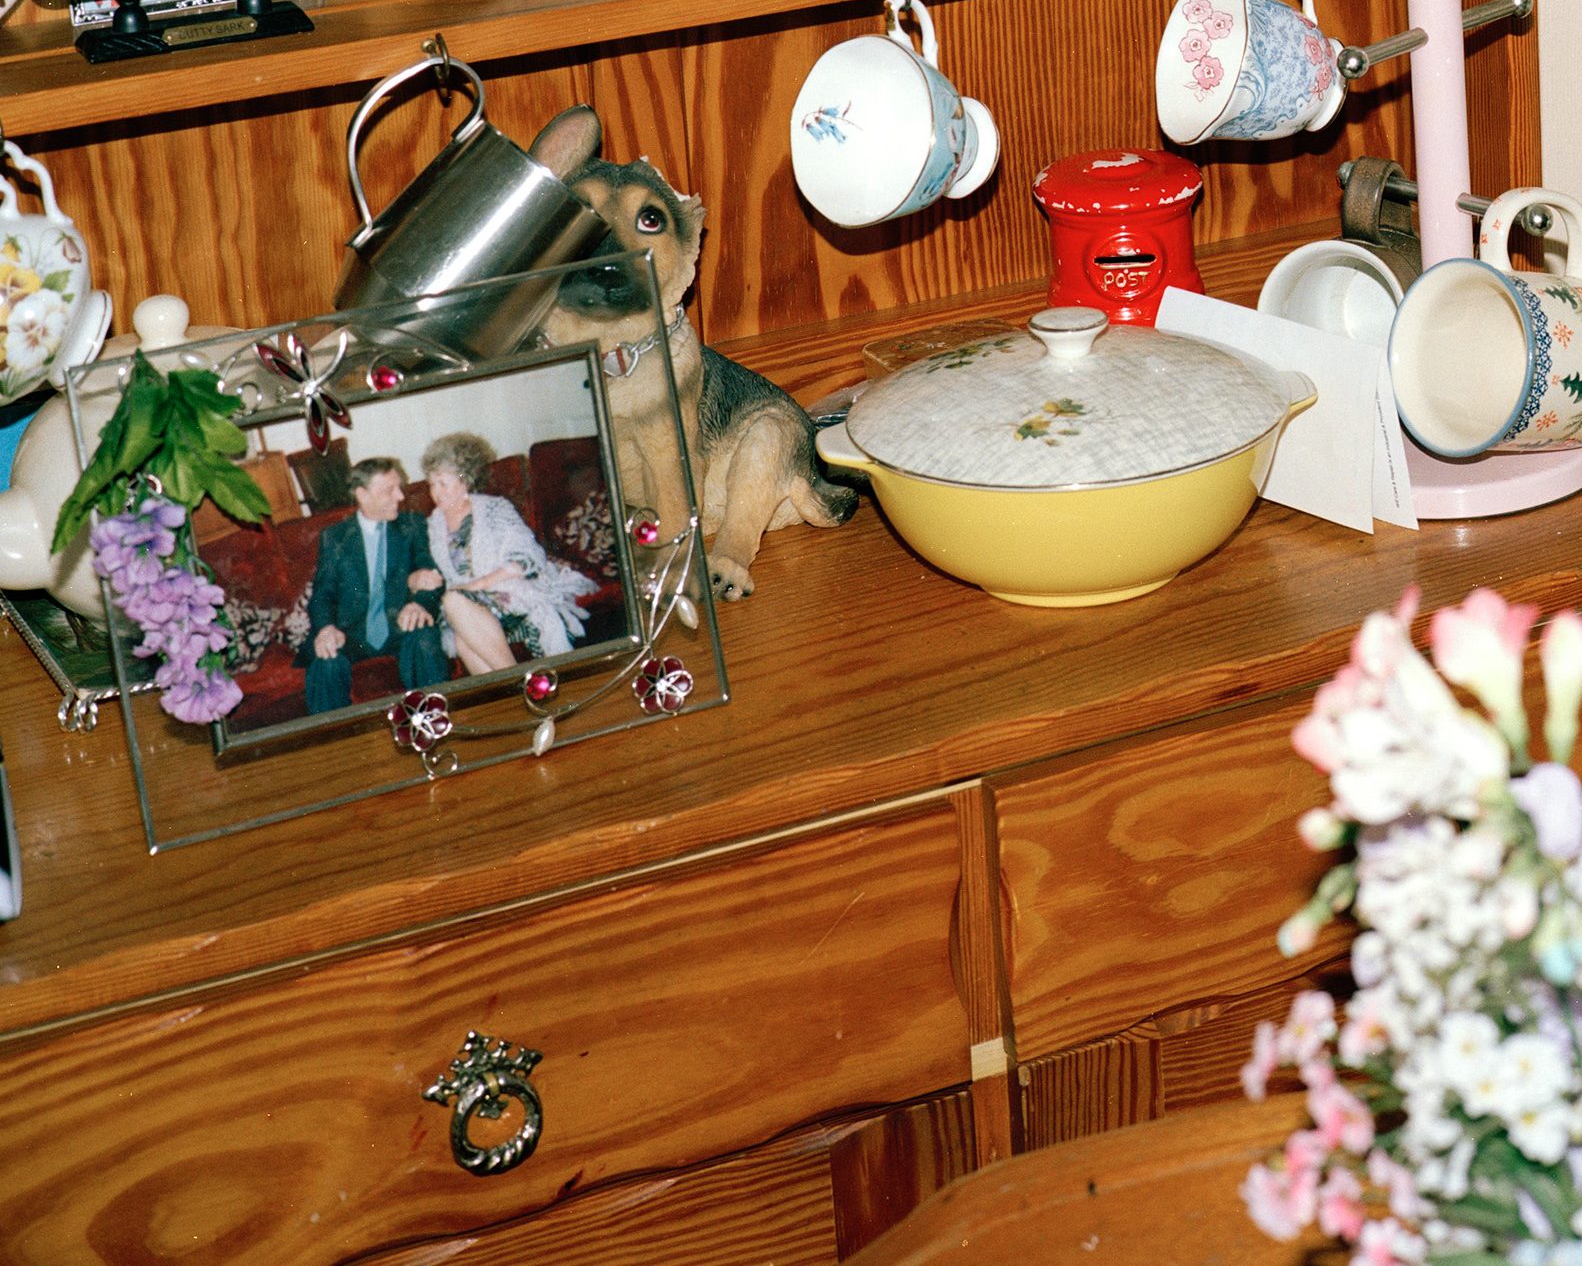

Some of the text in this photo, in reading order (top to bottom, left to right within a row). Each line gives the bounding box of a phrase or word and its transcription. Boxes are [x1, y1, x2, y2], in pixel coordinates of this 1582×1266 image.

[179, 22, 245, 39] CUTTY SARK
[1103, 271, 1151, 291] POST
